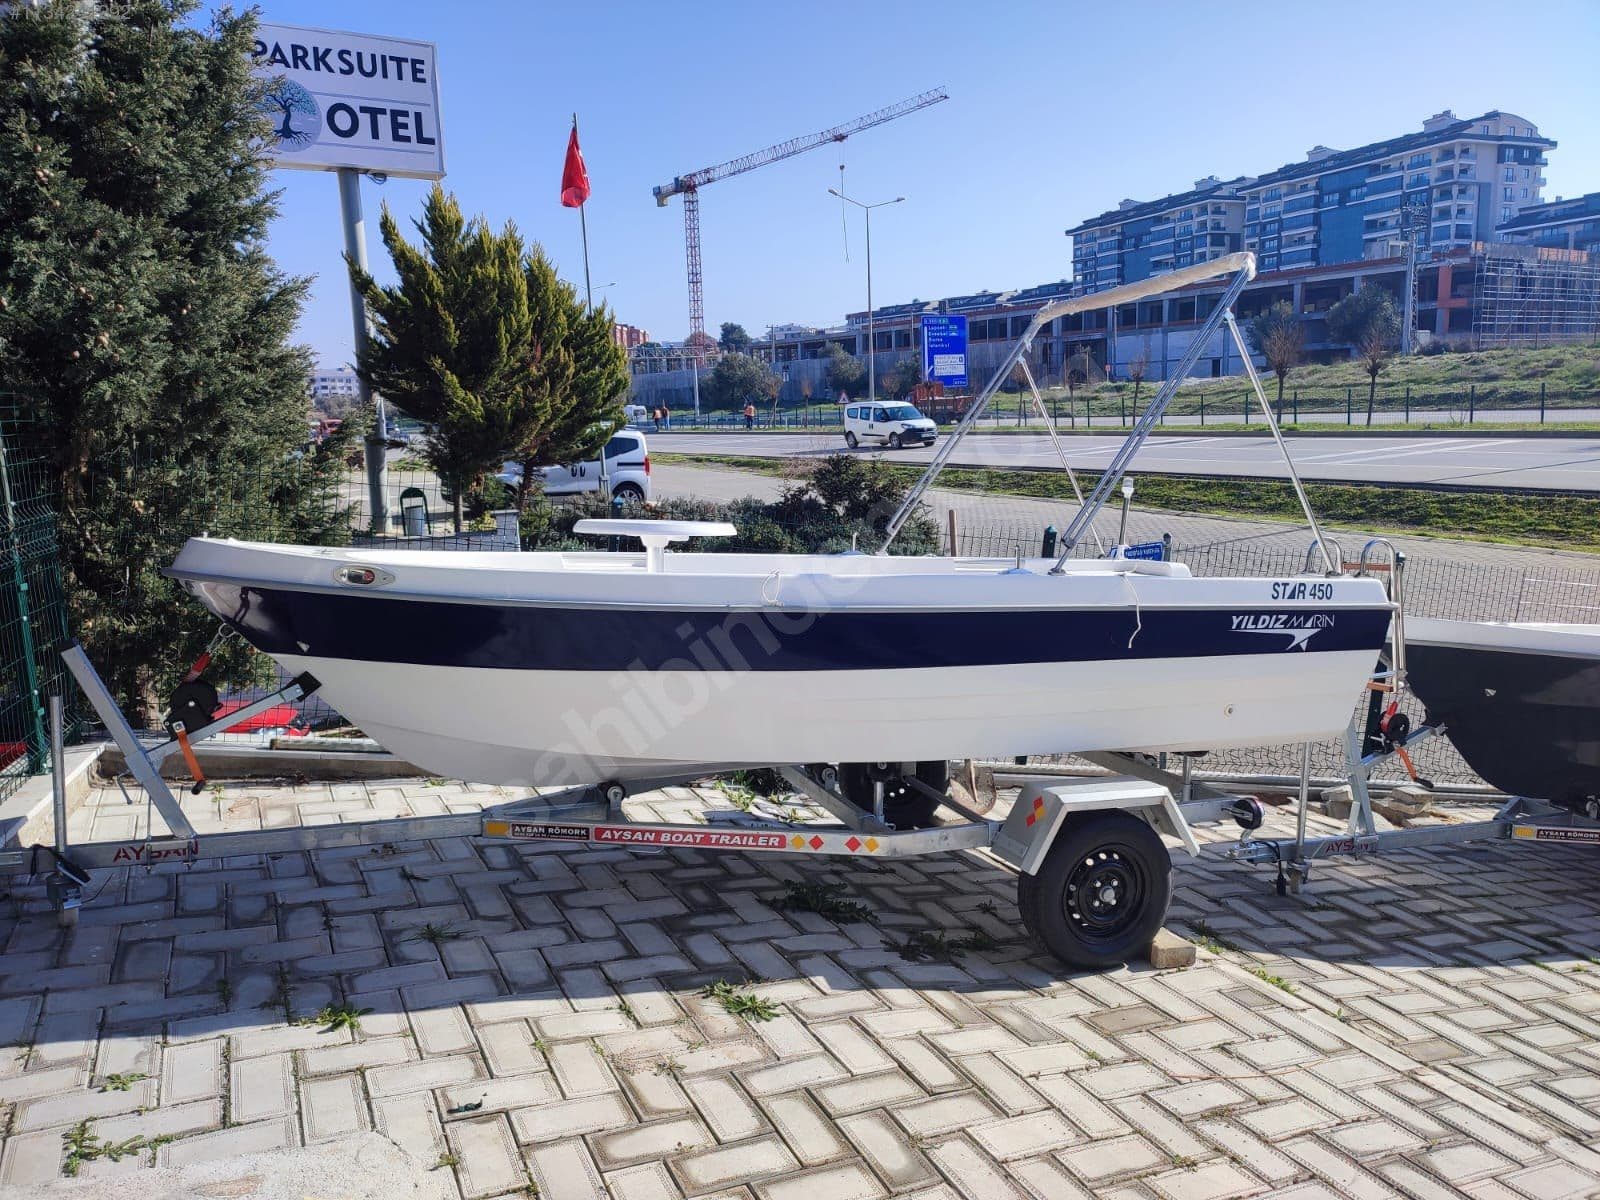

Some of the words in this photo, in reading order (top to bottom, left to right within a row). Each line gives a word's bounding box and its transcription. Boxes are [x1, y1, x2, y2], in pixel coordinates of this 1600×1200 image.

[251, 39, 427, 84] PARKSUITE
[326, 102, 436, 146] OTEL
[1271, 582, 1306, 600] STAR
[1309, 583, 1333, 600] 450
[601, 830, 655, 841] AYSAN
[660, 833, 704, 843] BOAT
[710, 834, 780, 847] TRAILER
